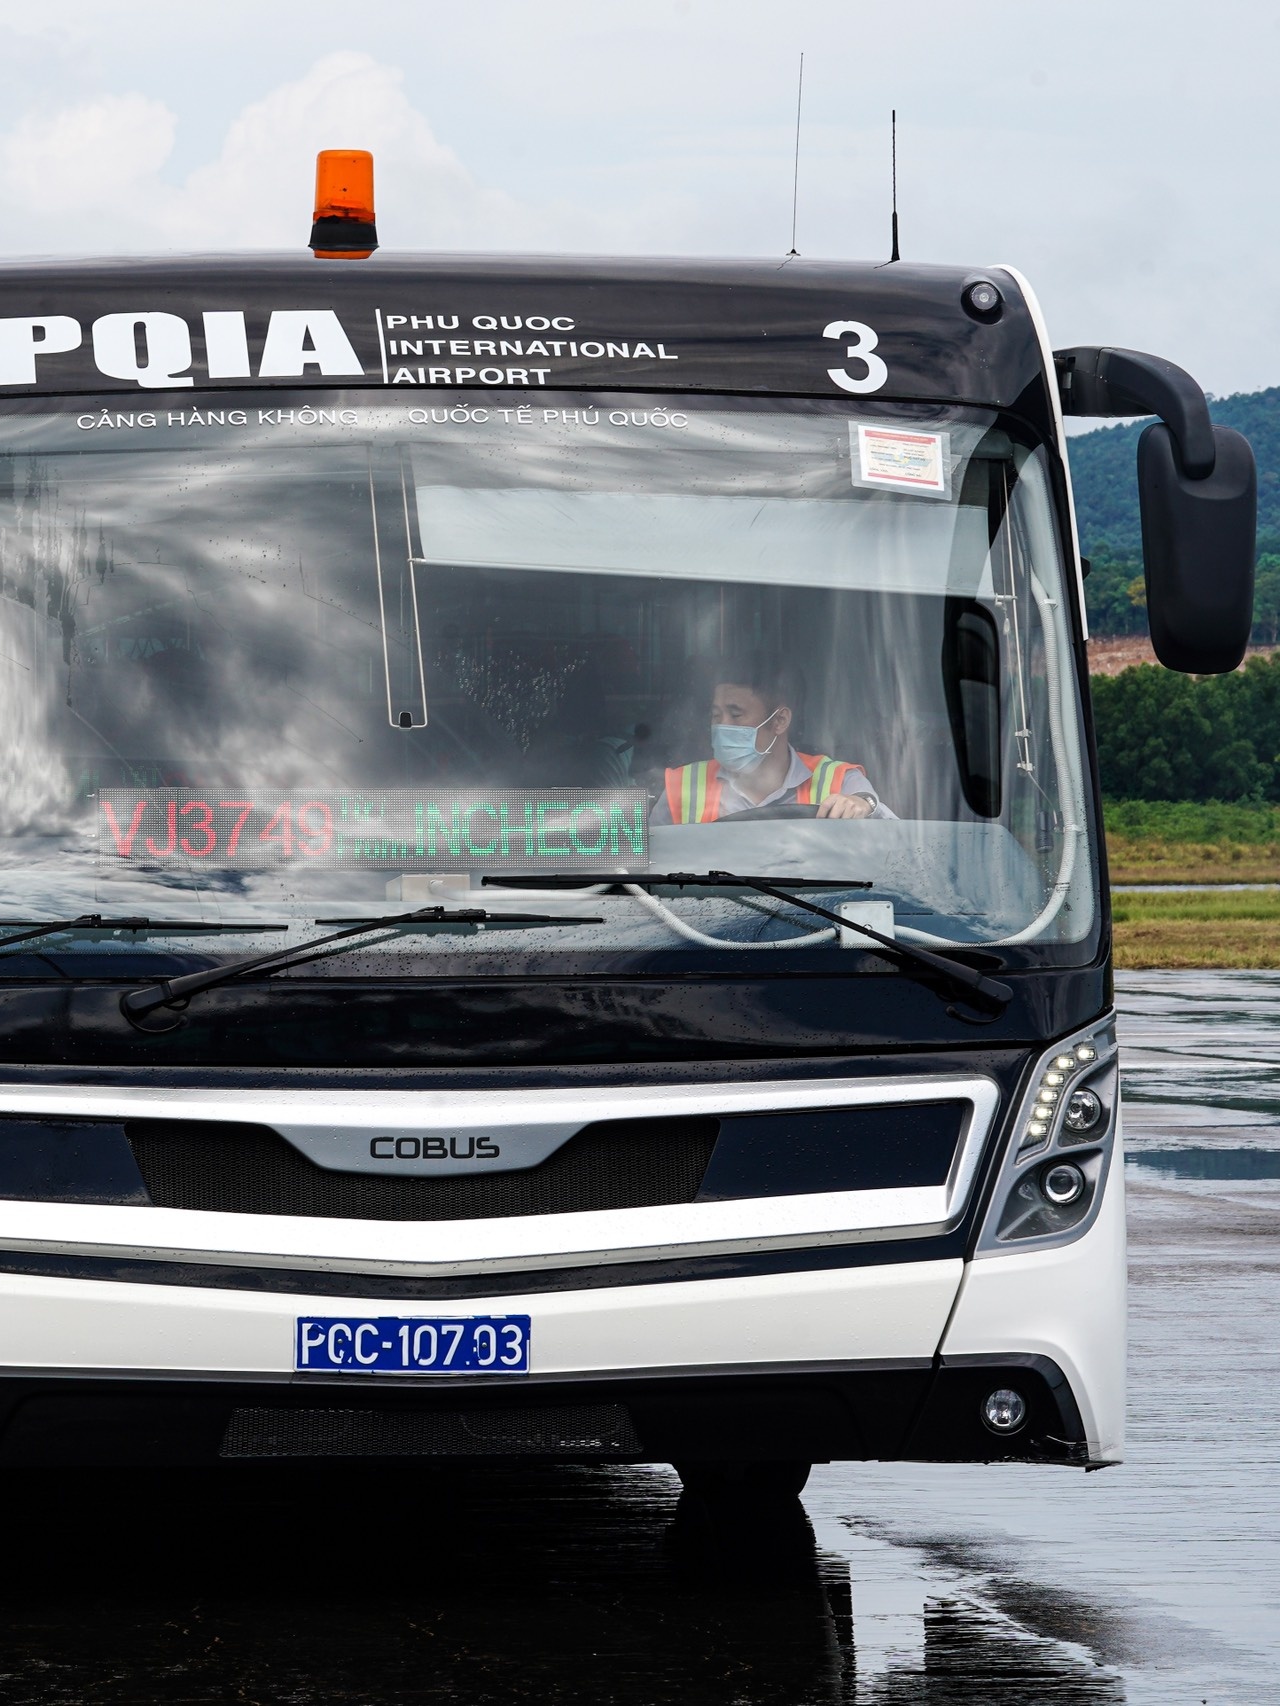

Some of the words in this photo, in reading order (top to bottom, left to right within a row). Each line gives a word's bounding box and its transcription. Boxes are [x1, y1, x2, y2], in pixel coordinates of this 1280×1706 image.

[385, 315, 460, 330] PHU
[471, 315, 576, 331] QUOC
[389, 340, 679, 360] INTERNATIONAL
[822, 320, 888, 394] 3
[391, 367, 552, 385] AIRPORT
[76, 408, 157, 430] CẢNG
[167, 406, 248, 427] HÀNG
[258, 405, 359, 426] KHÔNG
[409, 403, 489, 424] QUỐC
[497, 404, 533, 425] TẾ
[542, 404, 600, 425] PHÚ
[608, 407, 689, 428] QUỐC
[100, 800, 334, 857] VJ3749
[415, 801, 644, 857] INCHEON
[370, 1136, 500, 1159] COBUS
